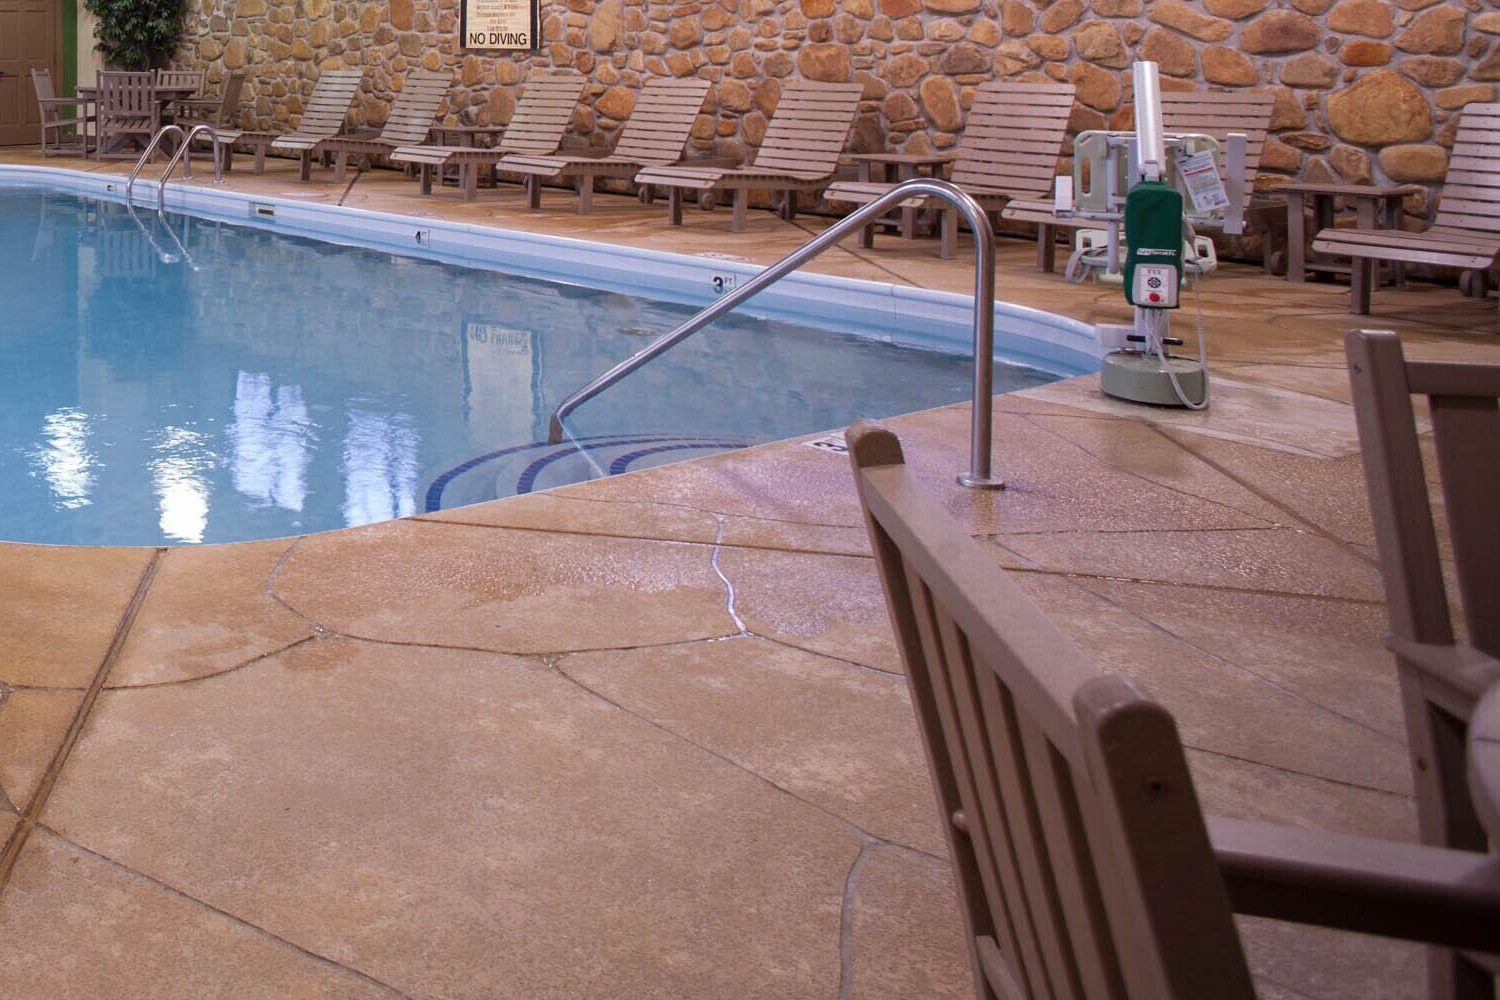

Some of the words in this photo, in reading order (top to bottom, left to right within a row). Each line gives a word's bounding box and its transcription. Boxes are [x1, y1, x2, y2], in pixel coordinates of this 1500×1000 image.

[469, 32, 486, 45] NO
[489, 32, 527, 45] DIVING
[713, 276, 723, 293] 3
